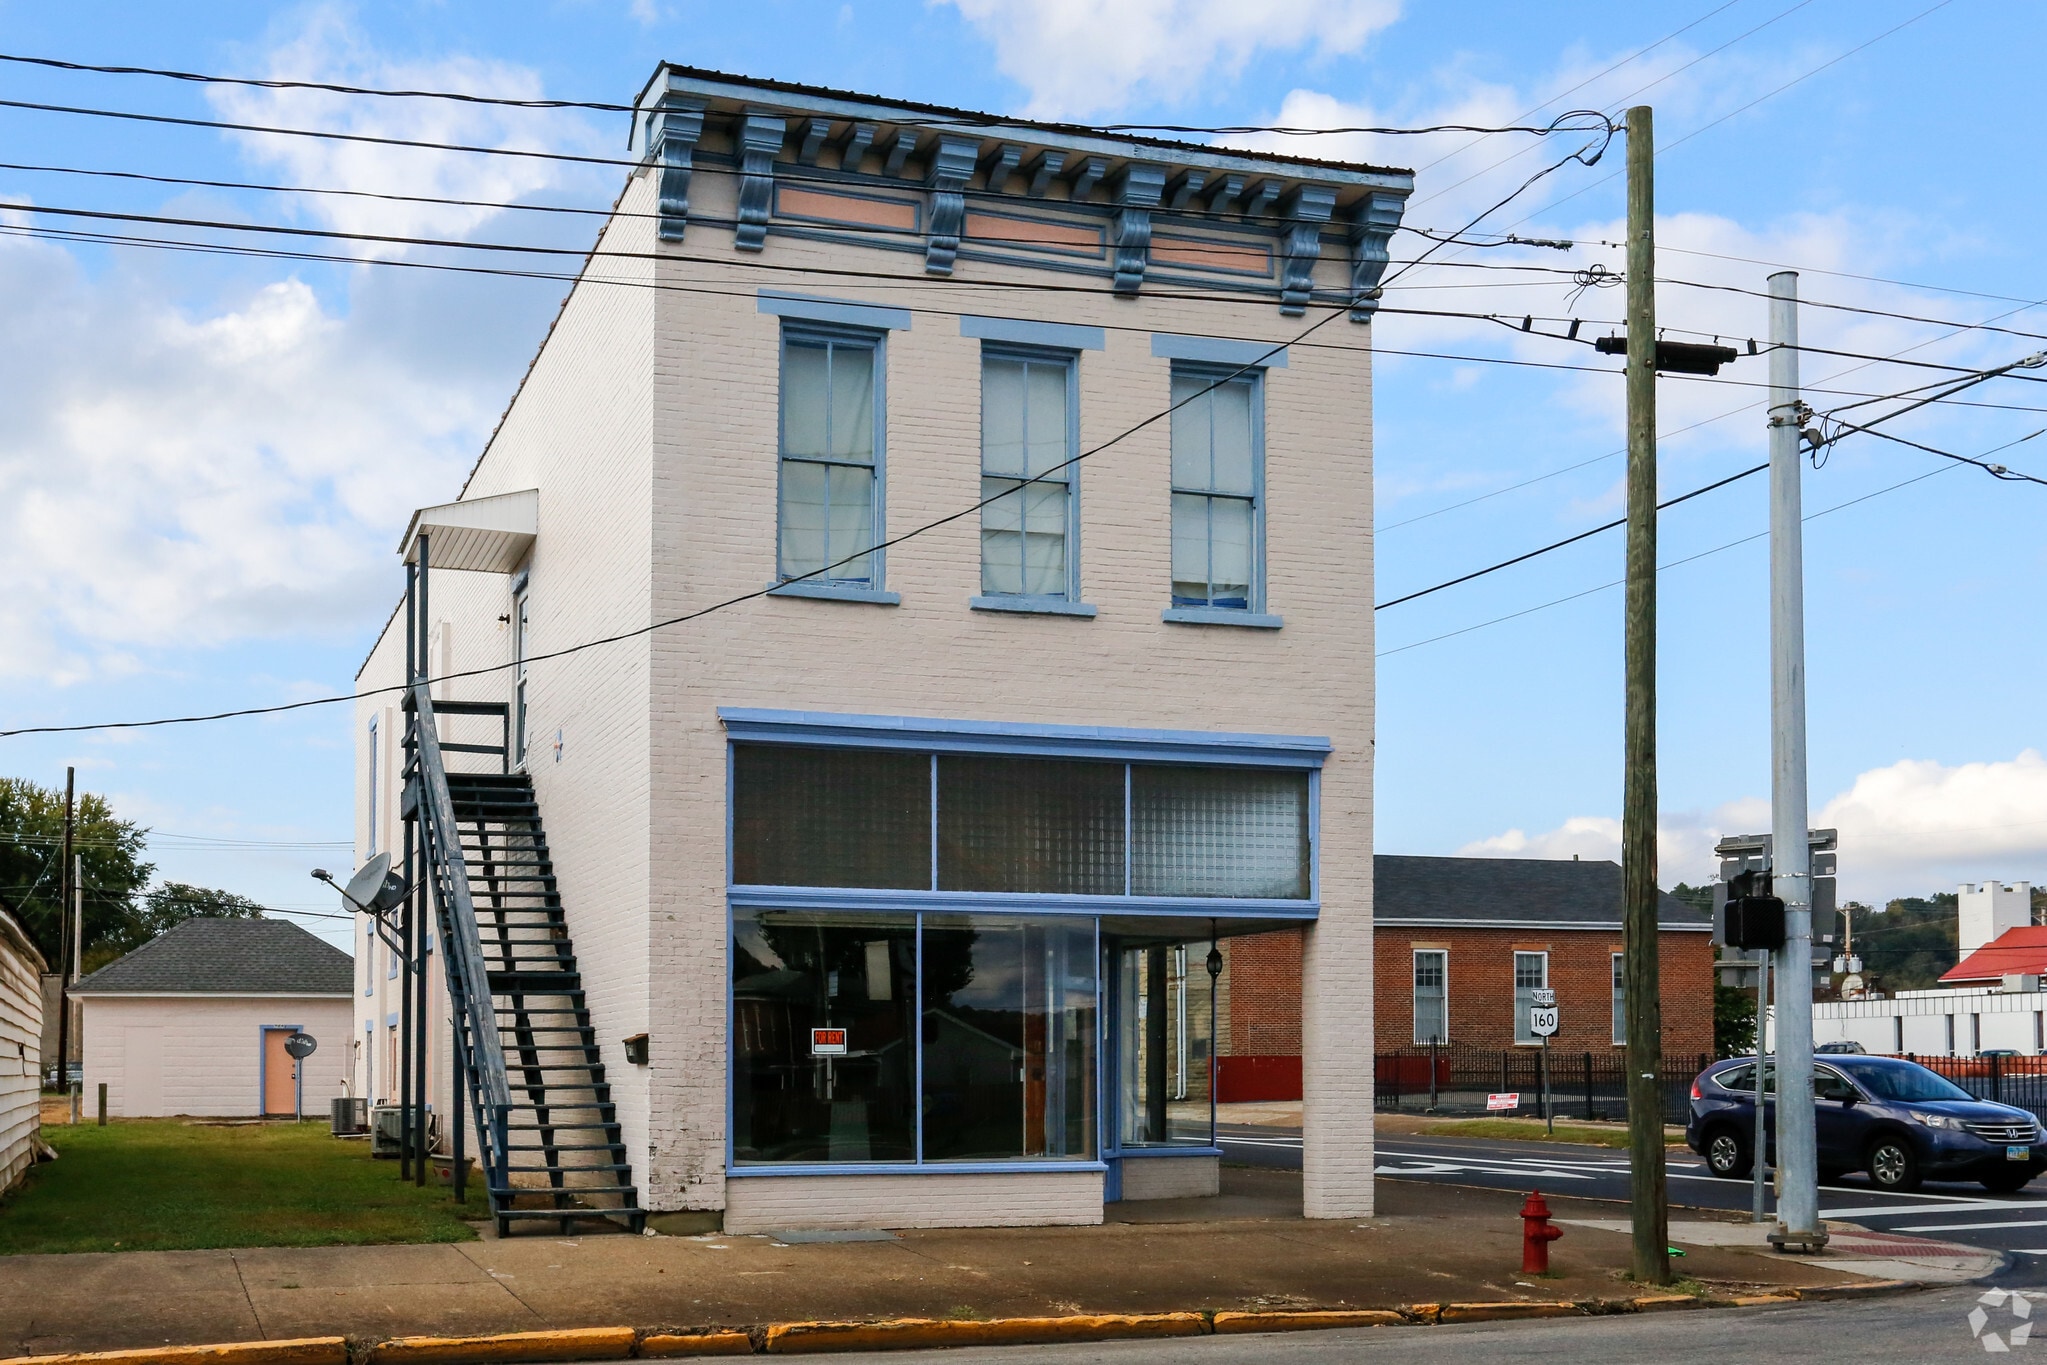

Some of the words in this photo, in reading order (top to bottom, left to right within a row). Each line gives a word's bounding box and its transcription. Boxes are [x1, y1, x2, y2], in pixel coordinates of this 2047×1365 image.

[1532, 991, 1555, 1001] NORTH
[1534, 1013, 1554, 1027] 160
[815, 1031, 827, 1044] FOR
[828, 1031, 843, 1044] RENT
